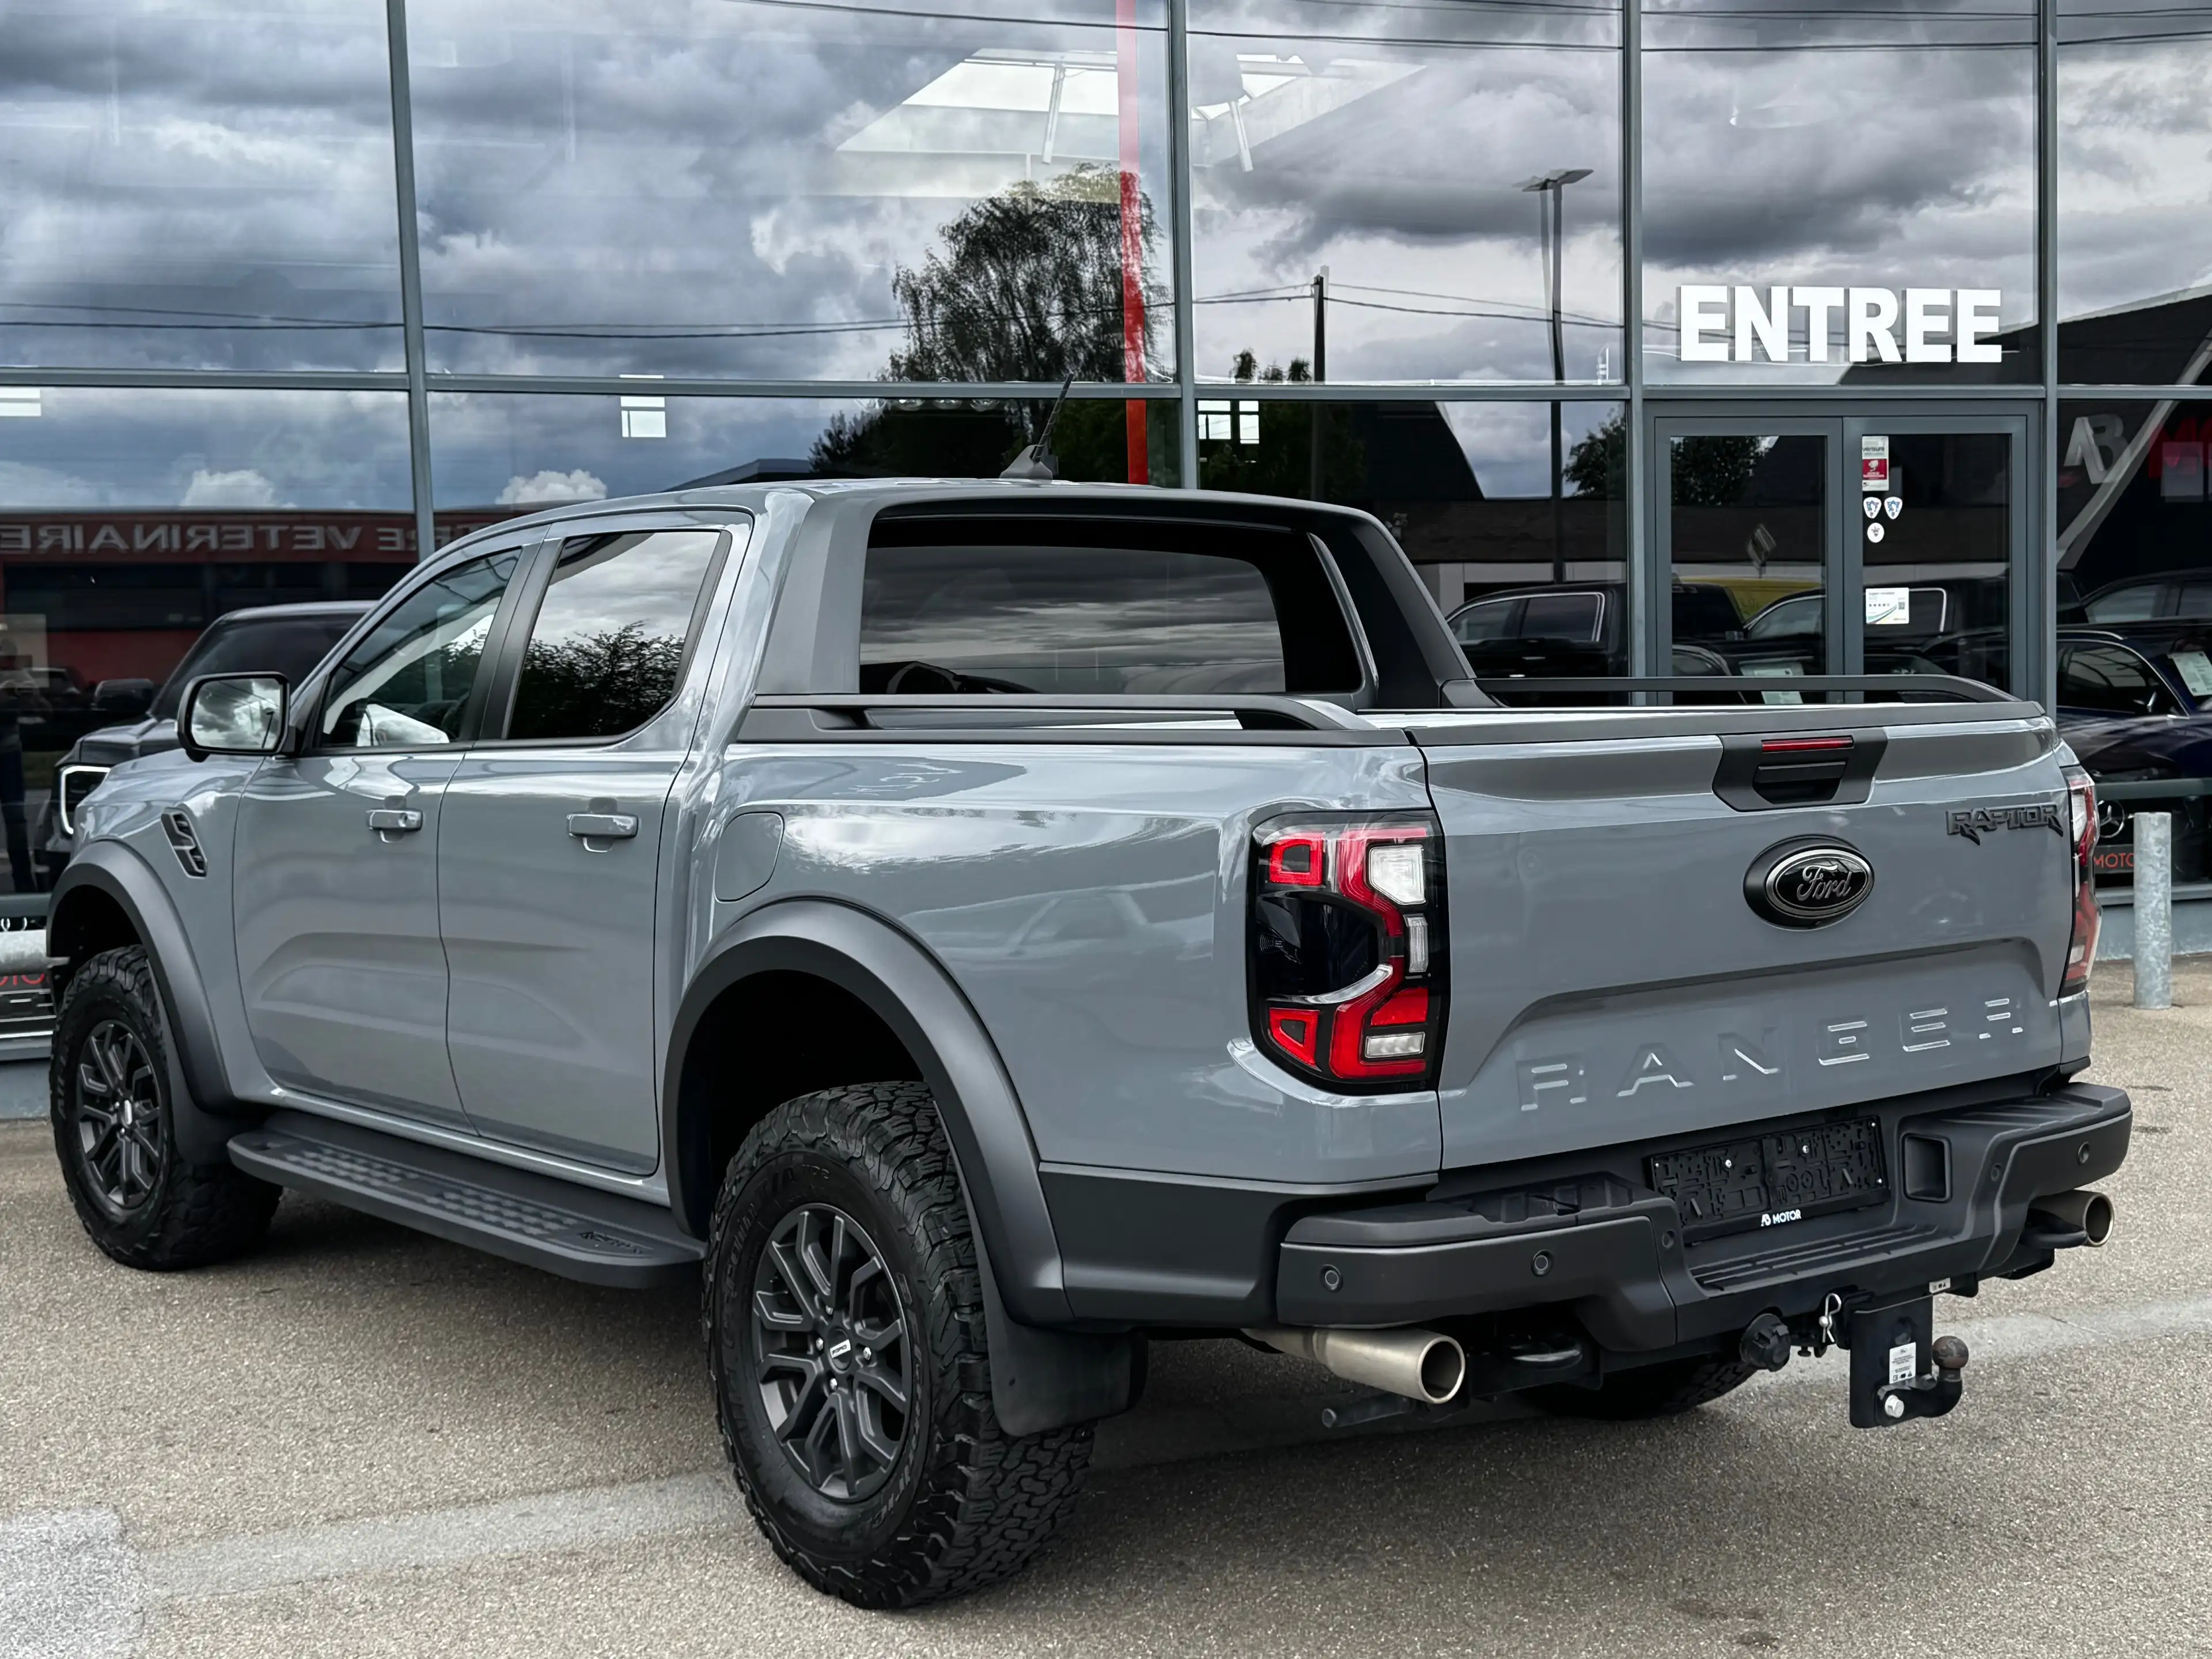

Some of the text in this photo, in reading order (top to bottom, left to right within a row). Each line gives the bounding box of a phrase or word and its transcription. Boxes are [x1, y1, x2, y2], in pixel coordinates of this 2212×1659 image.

[1680, 285, 2002, 363] ENTREE
[1946, 802, 2063, 846] RAPTOR
[1796, 864, 1853, 902] Ford
[1516, 996, 2025, 1112] RANGER
[1772, 1209, 1802, 1224] MOTOR
